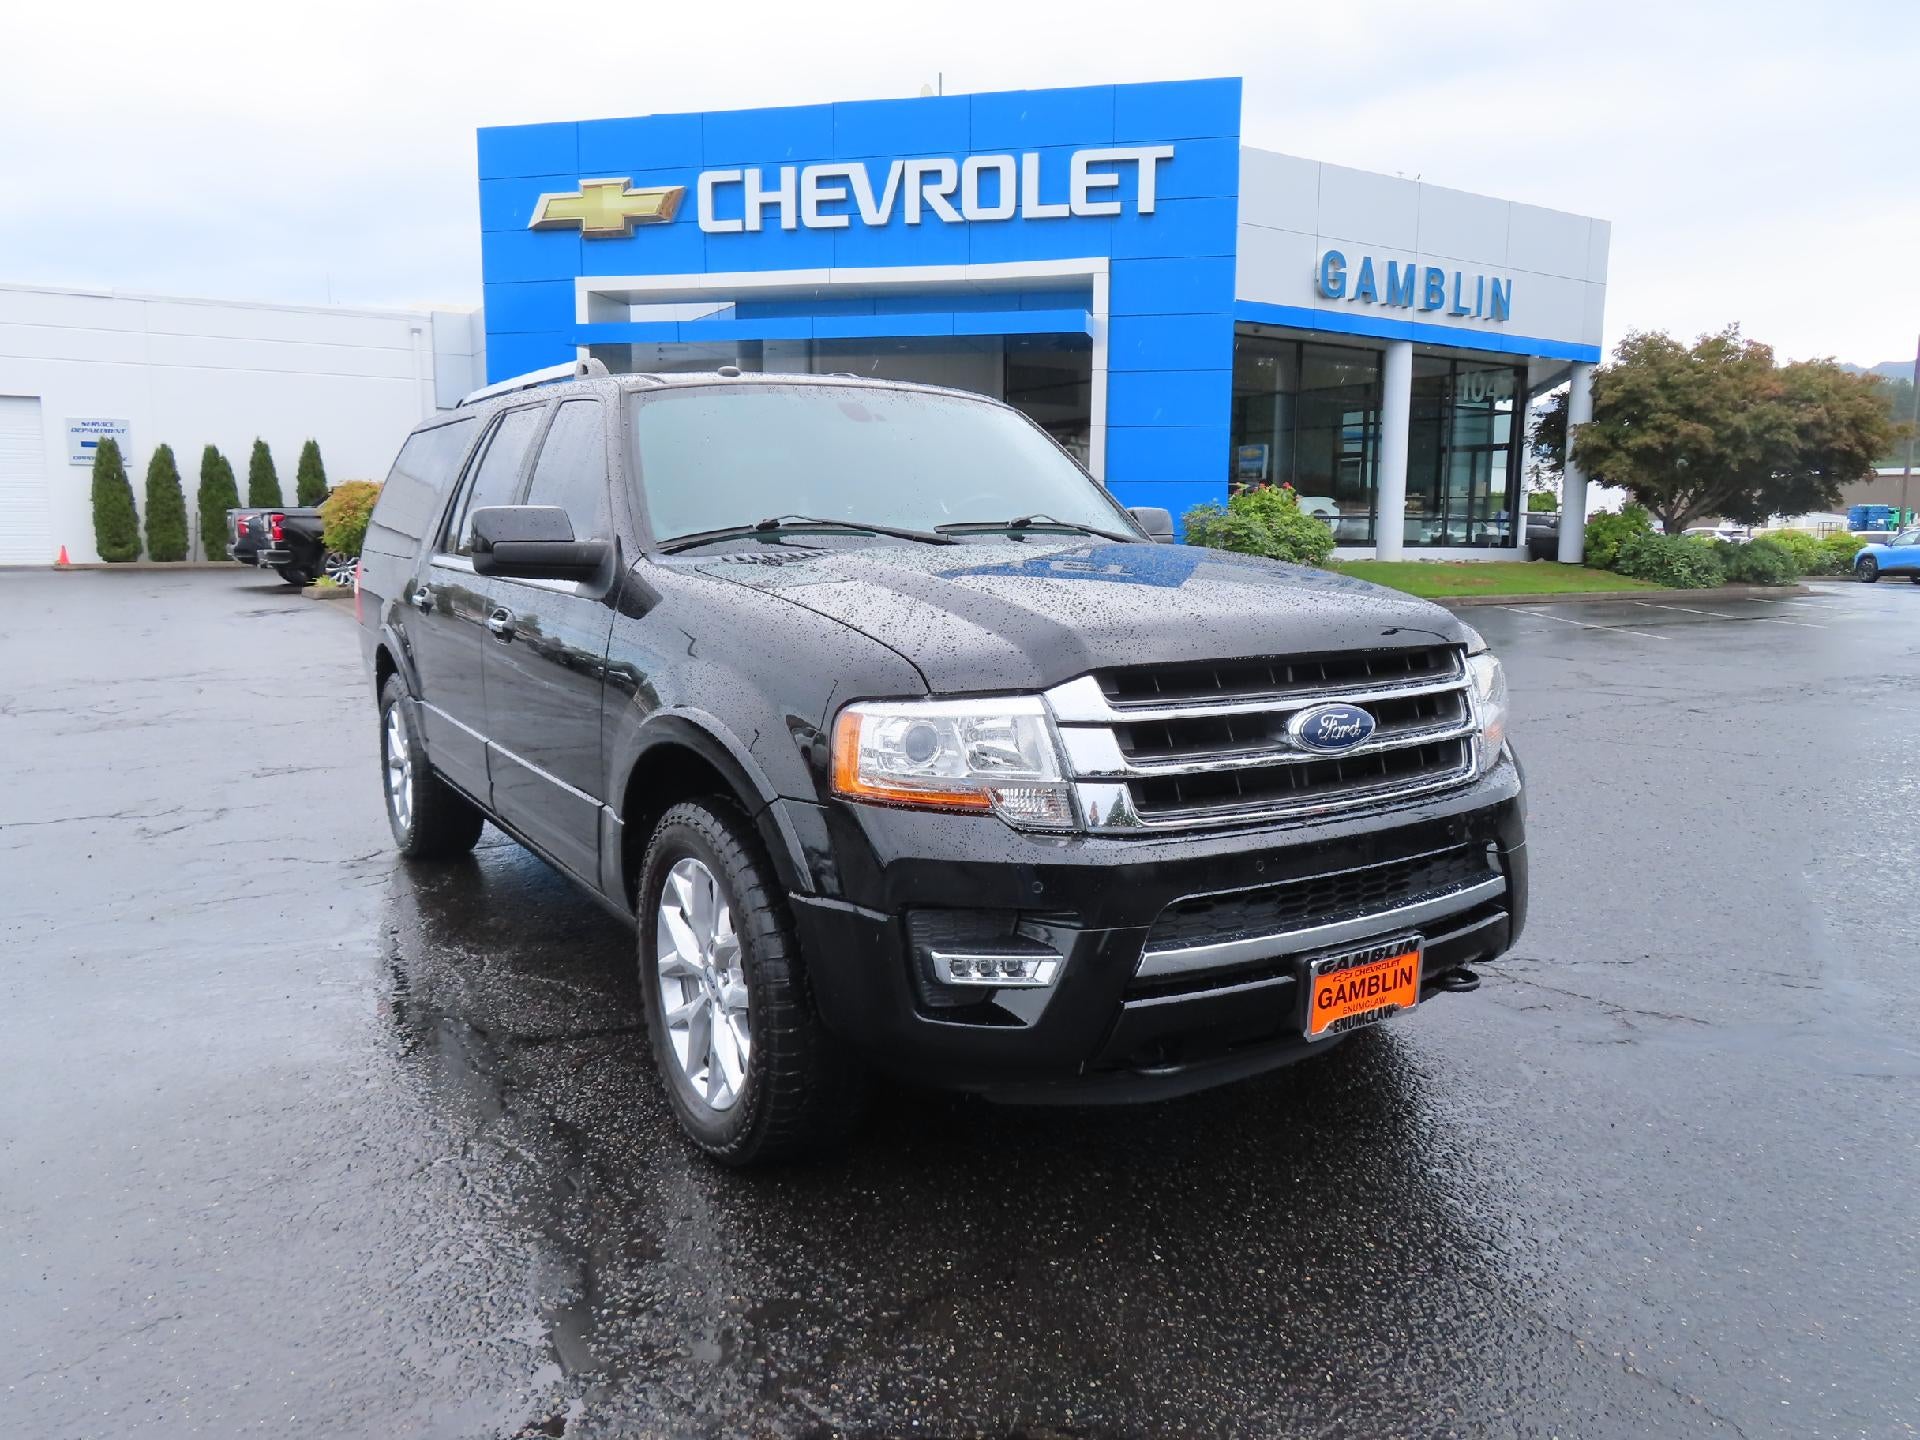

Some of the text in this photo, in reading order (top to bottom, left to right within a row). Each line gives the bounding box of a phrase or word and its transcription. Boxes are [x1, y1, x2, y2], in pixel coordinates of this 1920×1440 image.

[698, 145, 1175, 233] CHEVROLET
[1317, 249, 1512, 322] GAMBLIN
[1317, 713, 1362, 741] Ford
[1317, 939, 1420, 975] GAMBLIN
[1354, 958, 1402, 977] CHEVROLET
[1317, 965, 1413, 1010] GAMBLIN
[1333, 1002, 1396, 1034] ENUMCLAW
[1342, 996, 1387, 1015] ENUMCLAW
